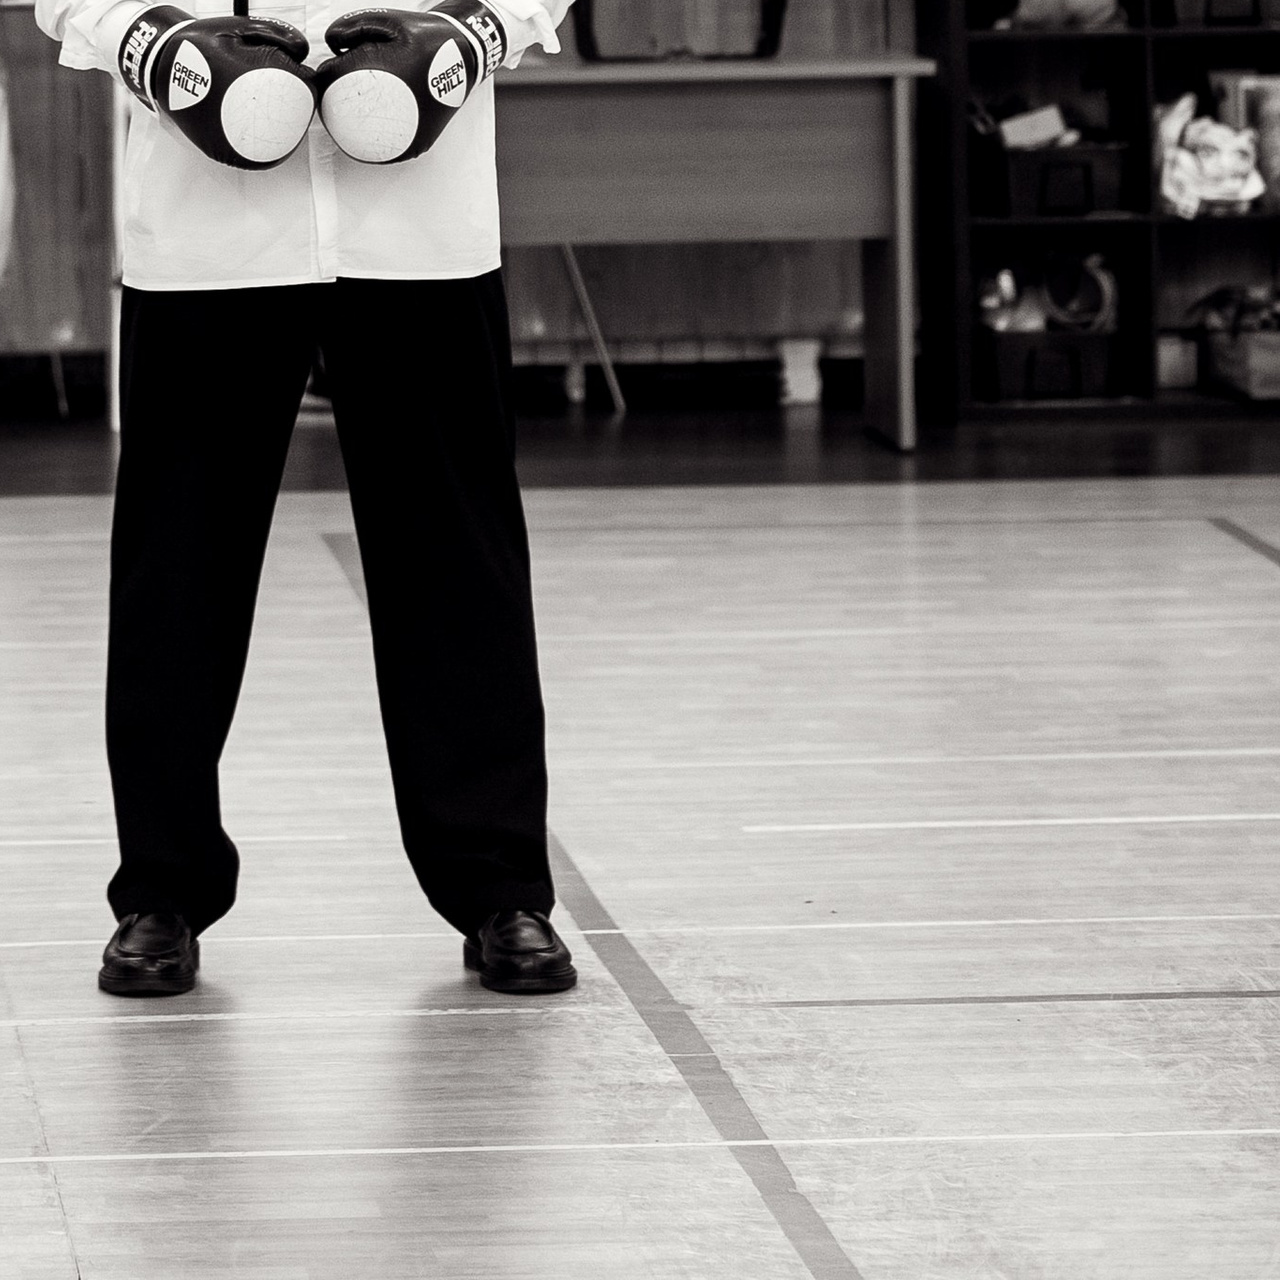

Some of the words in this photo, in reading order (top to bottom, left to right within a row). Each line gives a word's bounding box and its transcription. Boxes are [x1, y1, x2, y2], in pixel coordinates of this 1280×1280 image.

[172, 71, 199, 97] HILL
[174, 61, 209, 88] GREEN
[431, 60, 464, 88] GREEN
[437, 74, 464, 98] HILL
